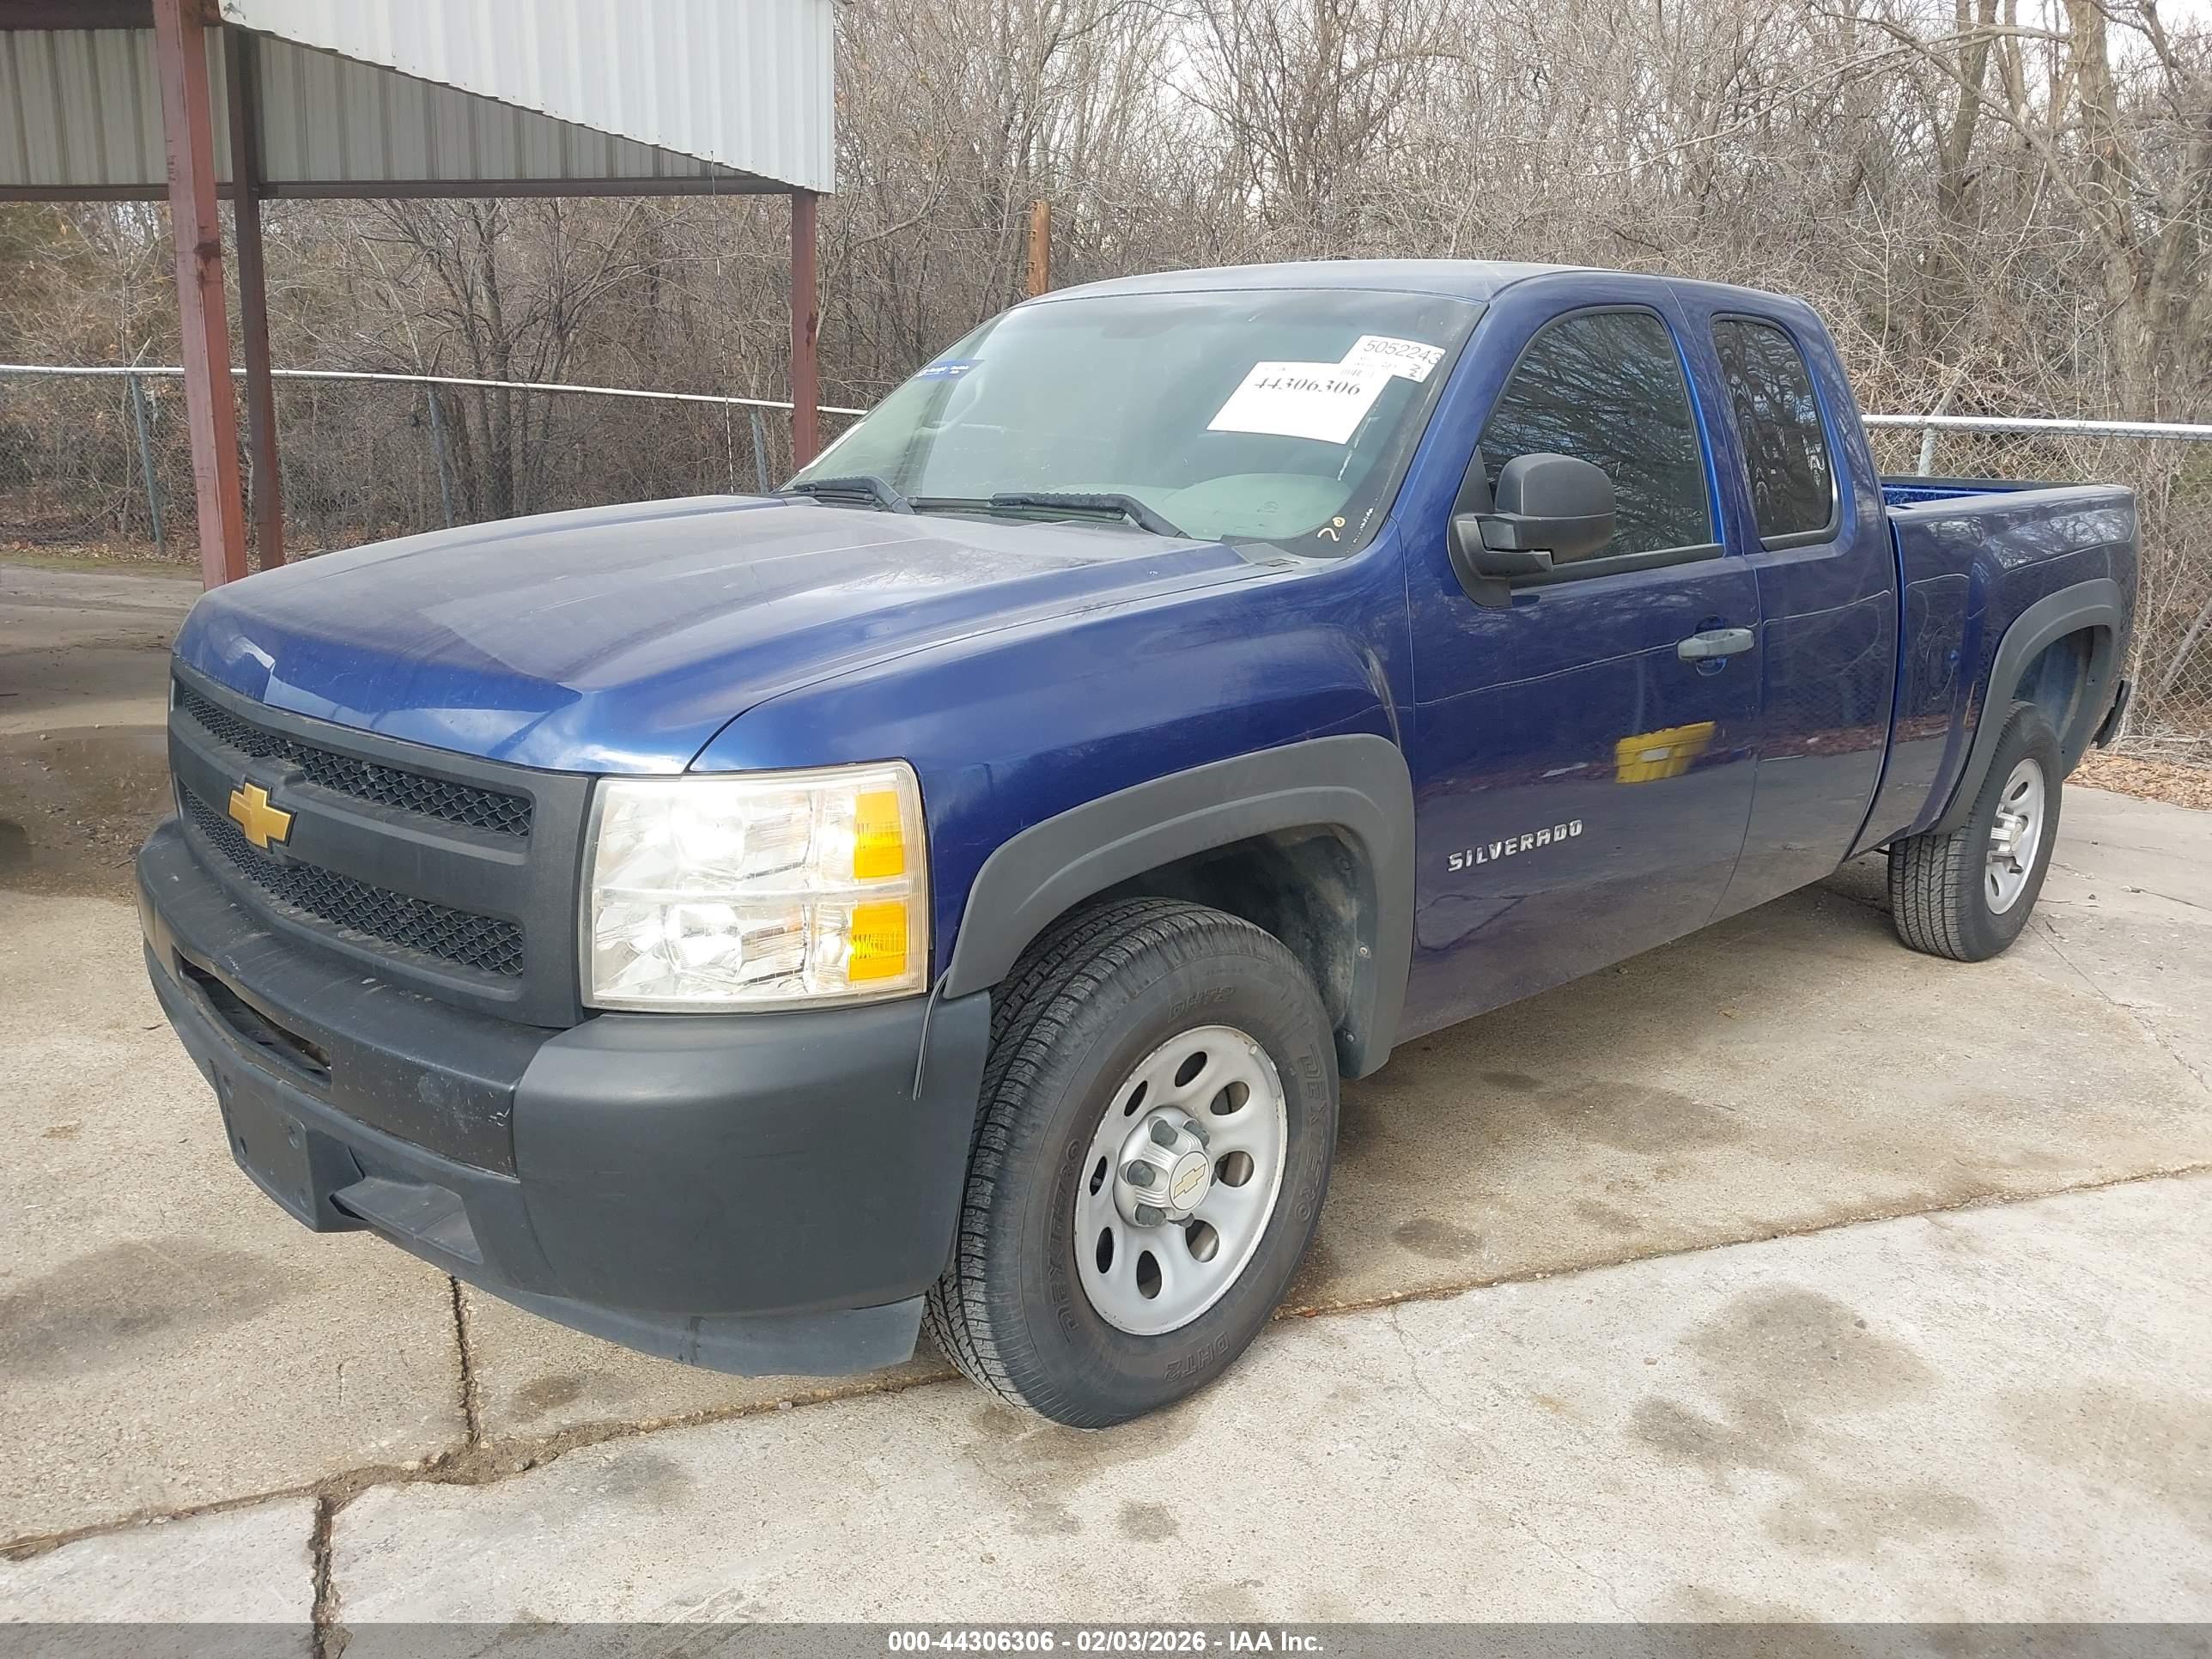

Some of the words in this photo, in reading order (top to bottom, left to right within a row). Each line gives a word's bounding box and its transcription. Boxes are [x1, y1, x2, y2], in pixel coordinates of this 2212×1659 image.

[1364, 339, 1443, 365] 5052243
[1255, 377, 1361, 396] 44306306
[1448, 819, 1583, 872] SILVERADO
[1164, 1331, 1230, 1382] DHT2
